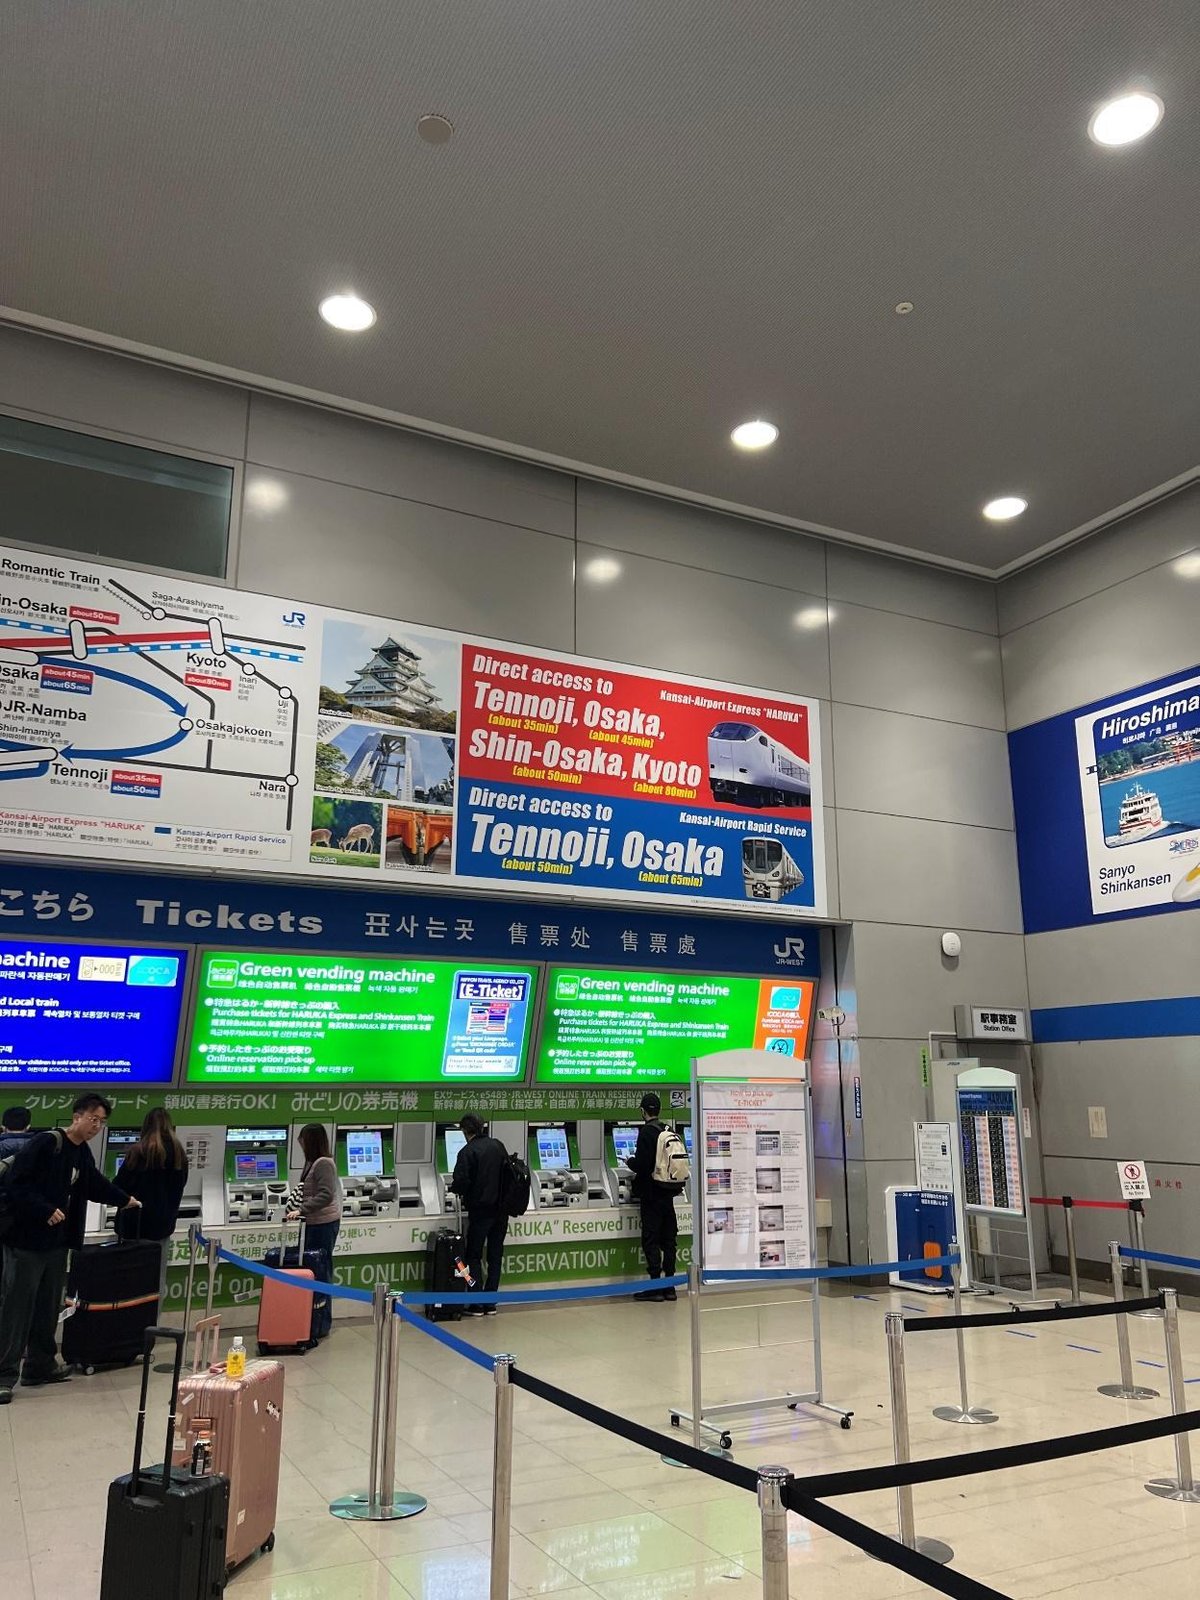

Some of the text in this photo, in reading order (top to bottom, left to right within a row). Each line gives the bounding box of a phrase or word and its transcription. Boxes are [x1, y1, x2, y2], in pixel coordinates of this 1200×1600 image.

[2, 558, 65, 579] Romantic
[69, 570, 100, 586] Train
[152, 591, 224, 610] Saga-Arashiyama
[282, 612, 305, 625] JR
[186, 652, 226, 668] Kyoto
[0, 666, 39, 680] saka
[45, 669, 90, 680] about45min
[240, 676, 257, 684] Inari
[473, 654, 614, 696] Direct access to
[43, 681, 90, 692] about65min
[4, 700, 86, 721] JR-Namba
[278, 700, 288, 708] Uji
[474, 680, 666, 740] Tennoji, Osaka,
[660, 690, 726, 710] Kansai-Airport
[727, 702, 762, 716] Express
[488, 713, 559, 735] (about 35min)
[1102, 695, 1200, 740] Hiroshima
[196, 718, 272, 738] Osakajokoen
[589, 730, 654, 749] (about 45min)
[469, 728, 702, 787] Shin-Osaka, Kyoto
[52, 763, 108, 782] Tennoji
[513, 765, 582, 785] (about 50min)
[112, 785, 159, 796] about50min
[260, 781, 286, 793] Nara
[634, 781, 697, 799] (about 80min)
[468, 786, 613, 822] Direct access to
[0, 812, 61, 824] Kansai-Airport
[64, 818, 98, 827] Express
[680, 812, 807, 838] Kansai-Airport Rapid Service
[176, 828, 286, 844] Kansai-Airport Rapid Service
[472, 813, 724, 877] Tennoji, Osaka
[502, 857, 574, 875] (about 50min)
[1100, 865, 1135, 880] Sanyo
[638, 872, 704, 888] (about 65min)
[1100, 874, 1171, 895] Shinkansen
[0, 889, 94, 922] こちら
[136, 899, 324, 934] Tickets
[364, 912, 476, 942] 표사는곳
[508, 922, 591, 949] 售票处
[620, 930, 696, 956] 售票處
[774, 937, 806, 960] JR
[776, 958, 805, 966] JR-WEST
[240, 962, 436, 984] Green vending machine
[581, 977, 620, 990] Green
[624, 980, 674, 996] vending
[678, 983, 730, 996] machine
[8, 997, 60, 1007] Local train
[212, 1008, 435, 1022] Purchase tickets for HARUKA Express and Shinkansen Train
[560, 1018, 587, 1026] Purchase
[980, 1013, 1017, 1024] 駅事務室
[984, 1024, 1000, 1032] Station
[206, 1054, 316, 1064] Online reservation pick-up
[554, 1058, 576, 1066] Online
[614, 1060, 637, 1068] pick-up
[164, 1094, 277, 1110] 領収書発行OK!
[291, 1090, 418, 1111] みどりの券売機
[548, 1090, 580, 1098] ONLINE
[672, 1092, 683, 1100] EX
[563, 1217, 623, 1234] Reserved
[229, 1277, 255, 1294] on
